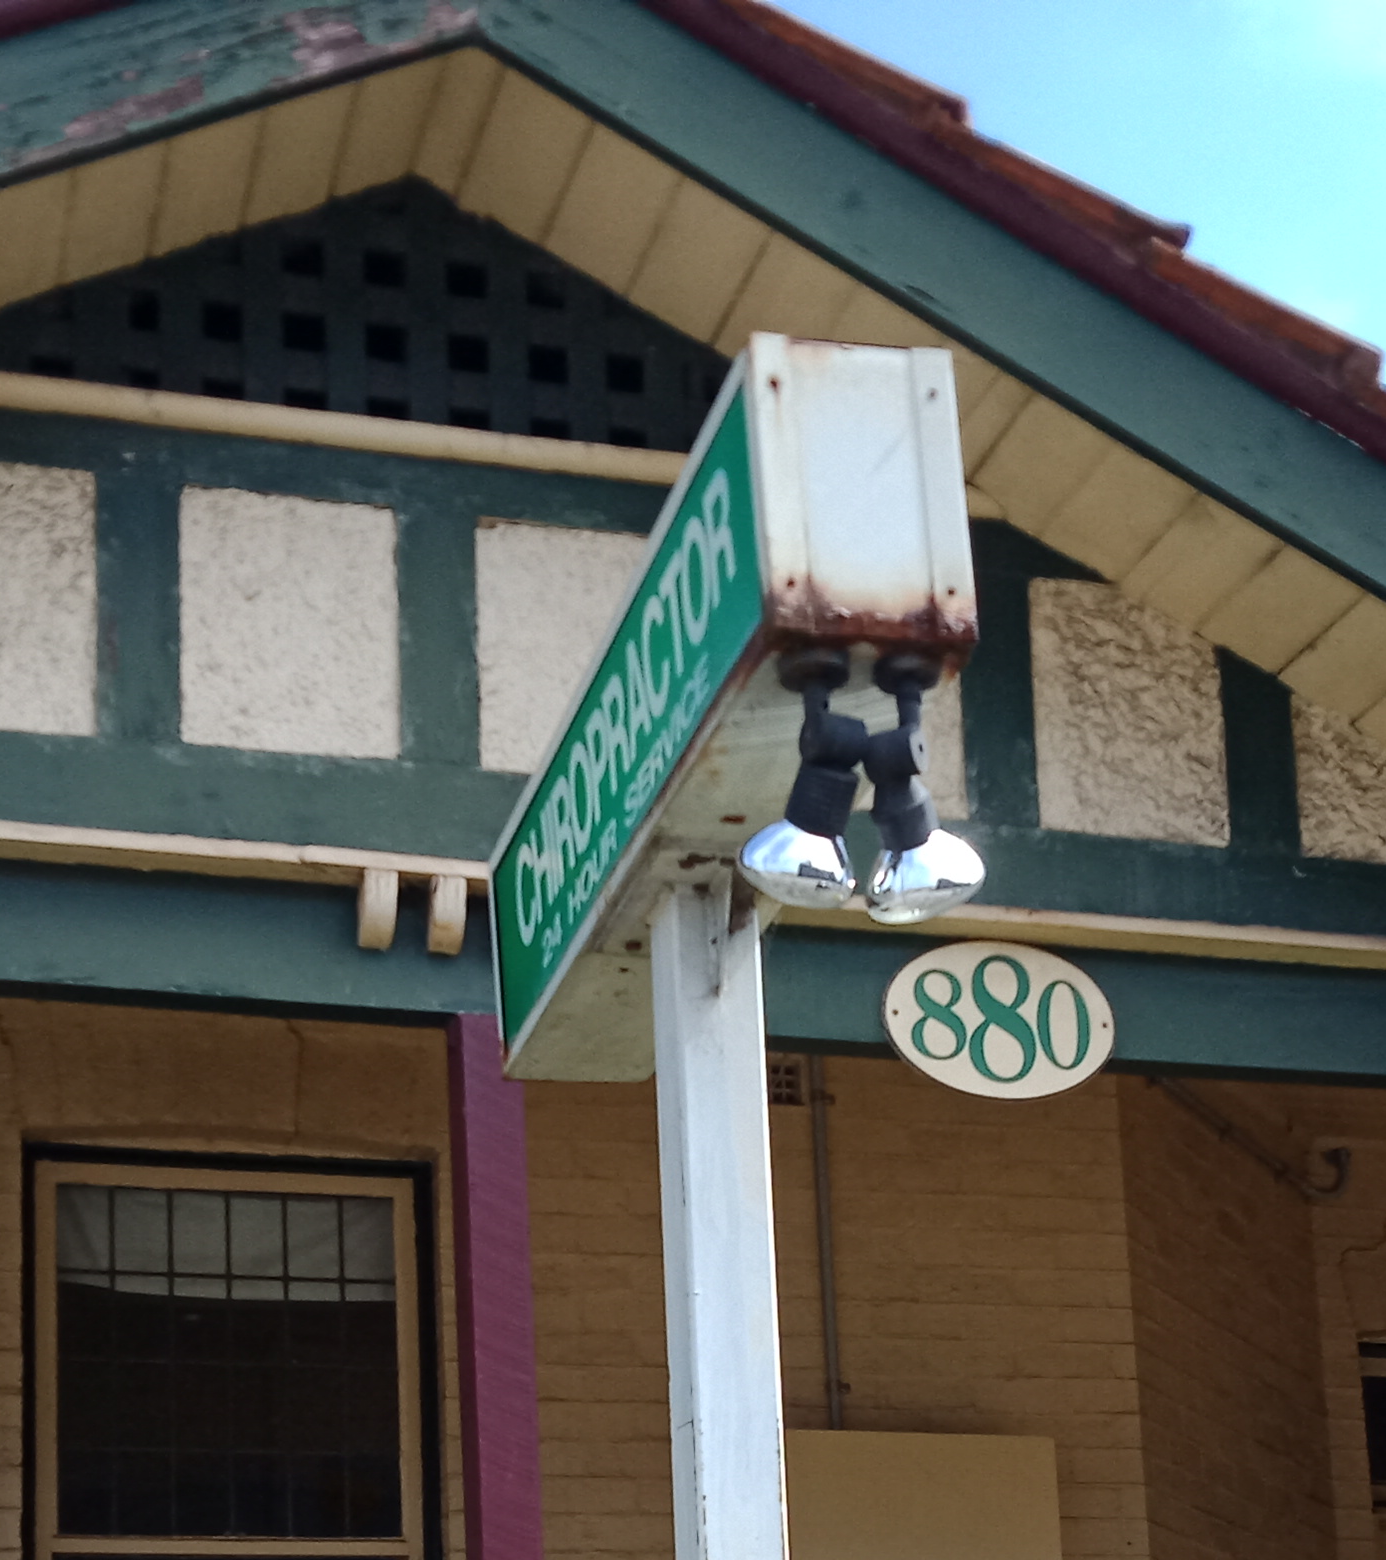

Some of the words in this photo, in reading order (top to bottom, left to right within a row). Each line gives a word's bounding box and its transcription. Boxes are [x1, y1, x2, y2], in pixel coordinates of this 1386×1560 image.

[515, 466, 737, 946] CHIROPRACTOR
[541, 911, 563, 969] 24
[567, 817, 618, 926] HOUR
[624, 651, 711, 828] SERVICE
[910, 954, 1091, 1084] 880
